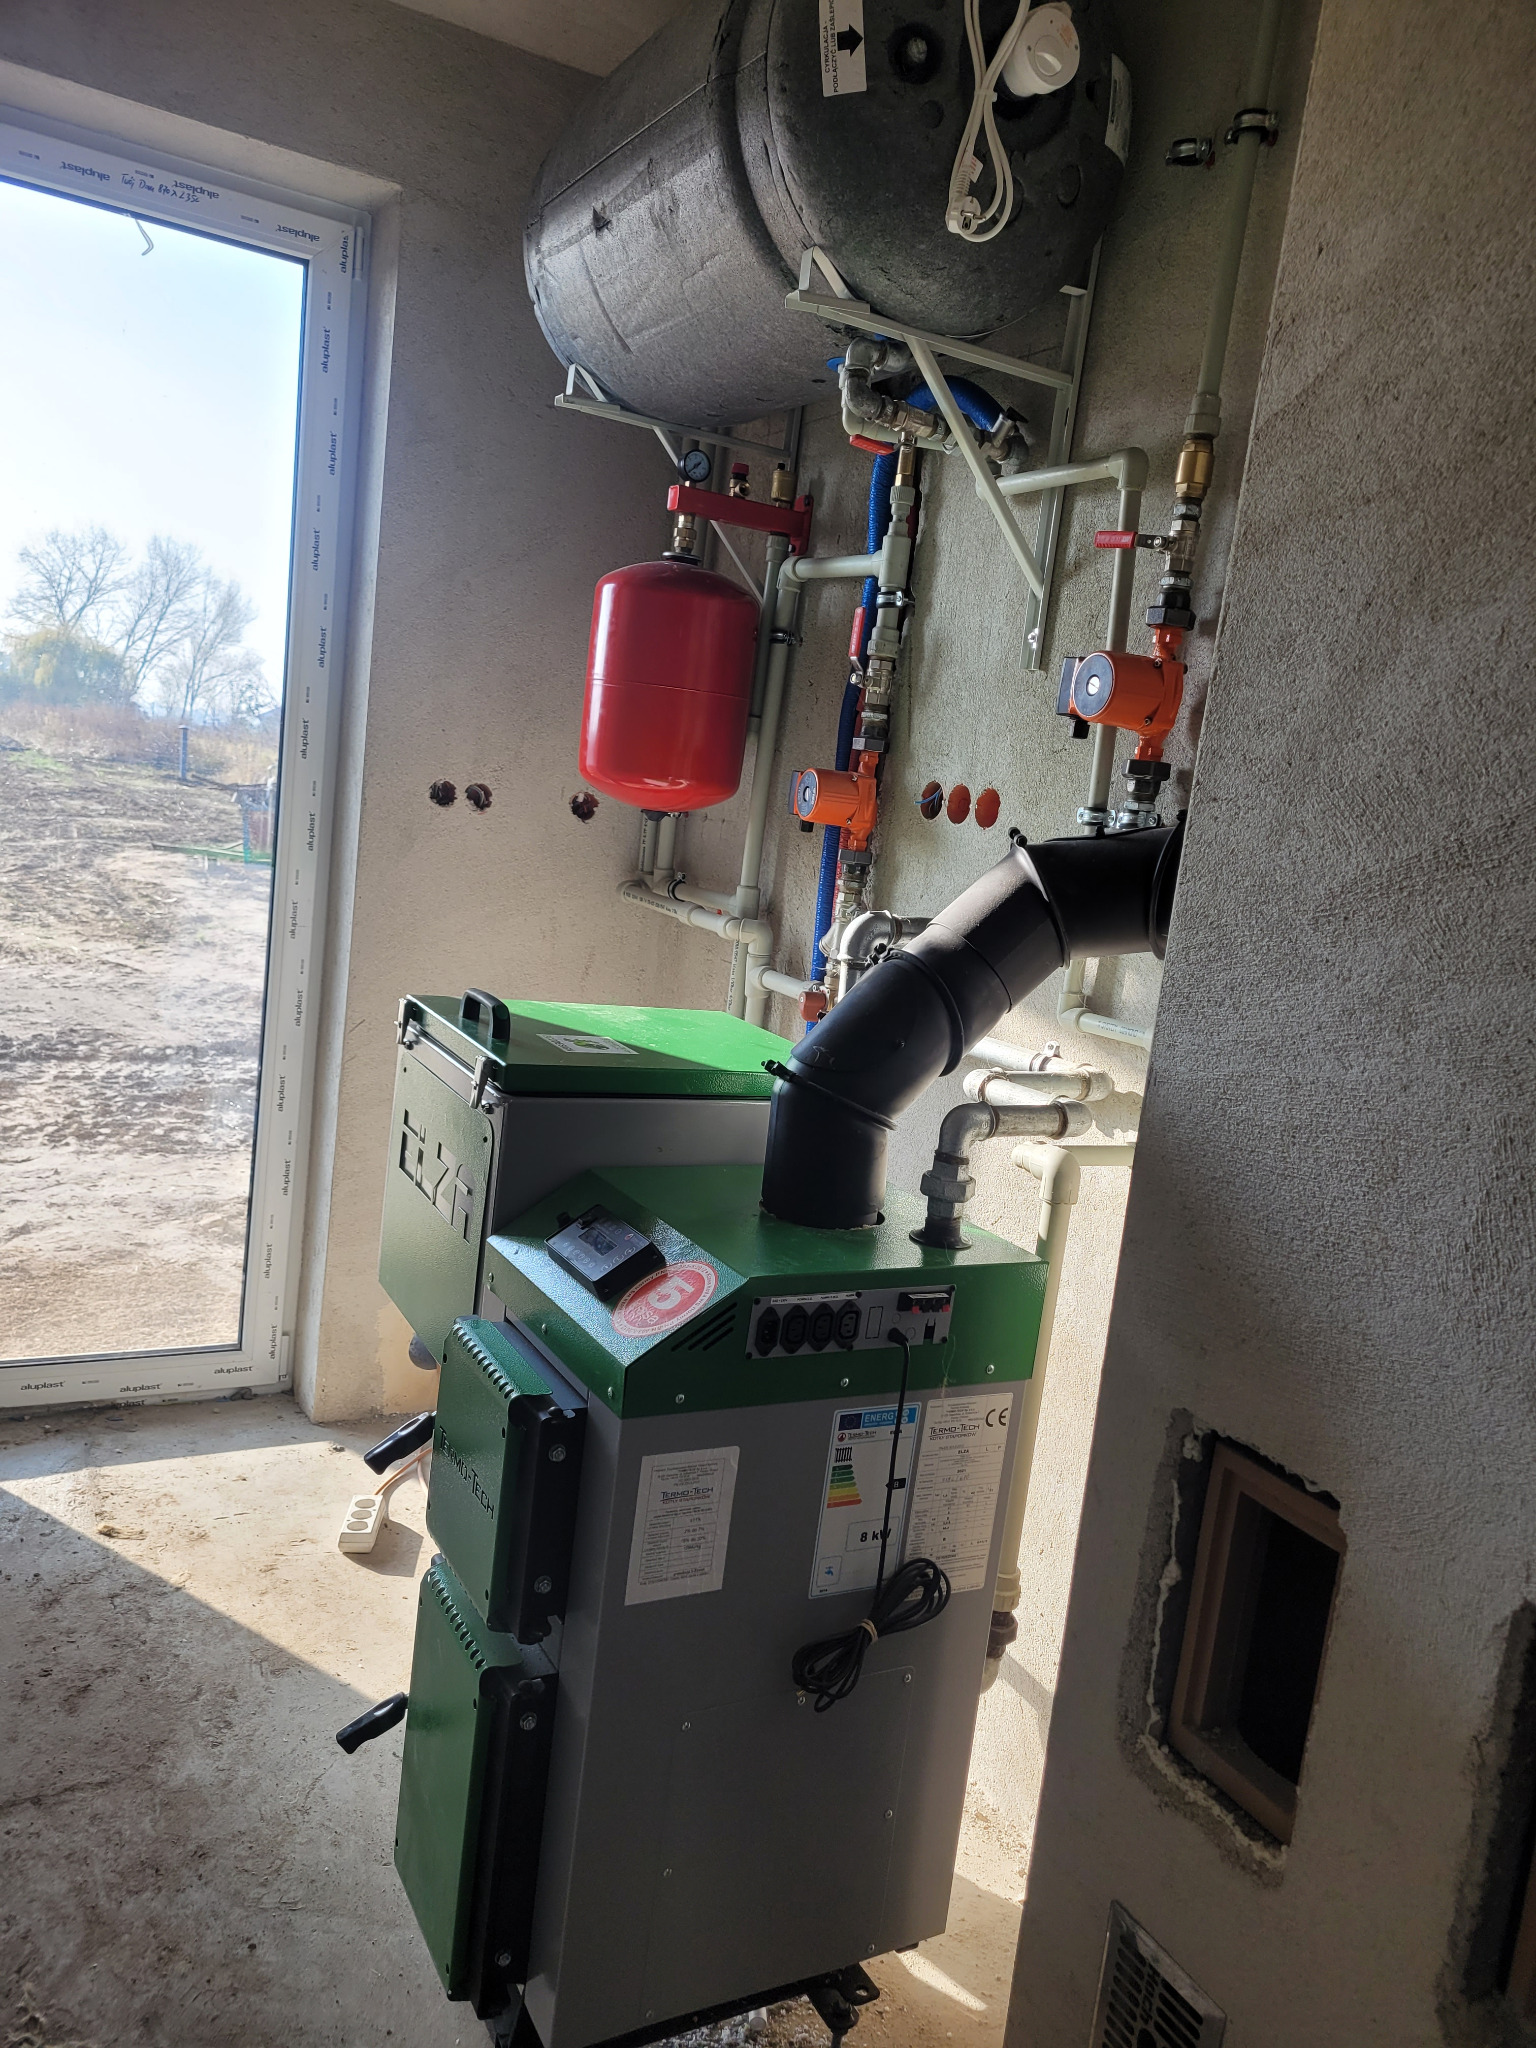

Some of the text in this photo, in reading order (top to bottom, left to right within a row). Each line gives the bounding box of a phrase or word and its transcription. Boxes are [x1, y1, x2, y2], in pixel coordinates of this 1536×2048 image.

[830, 49, 839, 93] PODŁĄCZYĆ
[60, 162, 111, 182] aluplast
[172, 180, 220, 199] aluplast
[276, 224, 320, 242] aluplast
[339, 235, 349, 273] aluplas
[321, 327, 331, 373] aluplast
[328, 431, 340, 475] aluplast
[311, 528, 322, 571] aluplast
[318, 626, 329, 668] aluplast
[299, 718, 310, 759] aluplast
[306, 811, 318, 851] aluplast
[288, 901, 300, 939] aluplast
[293, 989, 304, 1027] aluplast
[275, 1074, 286, 1112] aluplast
[281, 1159, 292, 1197] aluplast
[263, 1243, 273, 1279] aluplast
[647, 1275, 695, 1310] 5
[269, 1324, 278, 1360] aluplast
[20, 1381, 65, 1391] aluplast
[119, 1384, 162, 1393] aluplast
[213, 1366, 253, 1375] aluplast
[864, 1412, 894, 1423] ENERG
[929, 1424, 979, 1435] TERMO-TECH
[661, 1487, 713, 1500] TERMO-TECH
[860, 1528, 892, 1542] 8 kW
